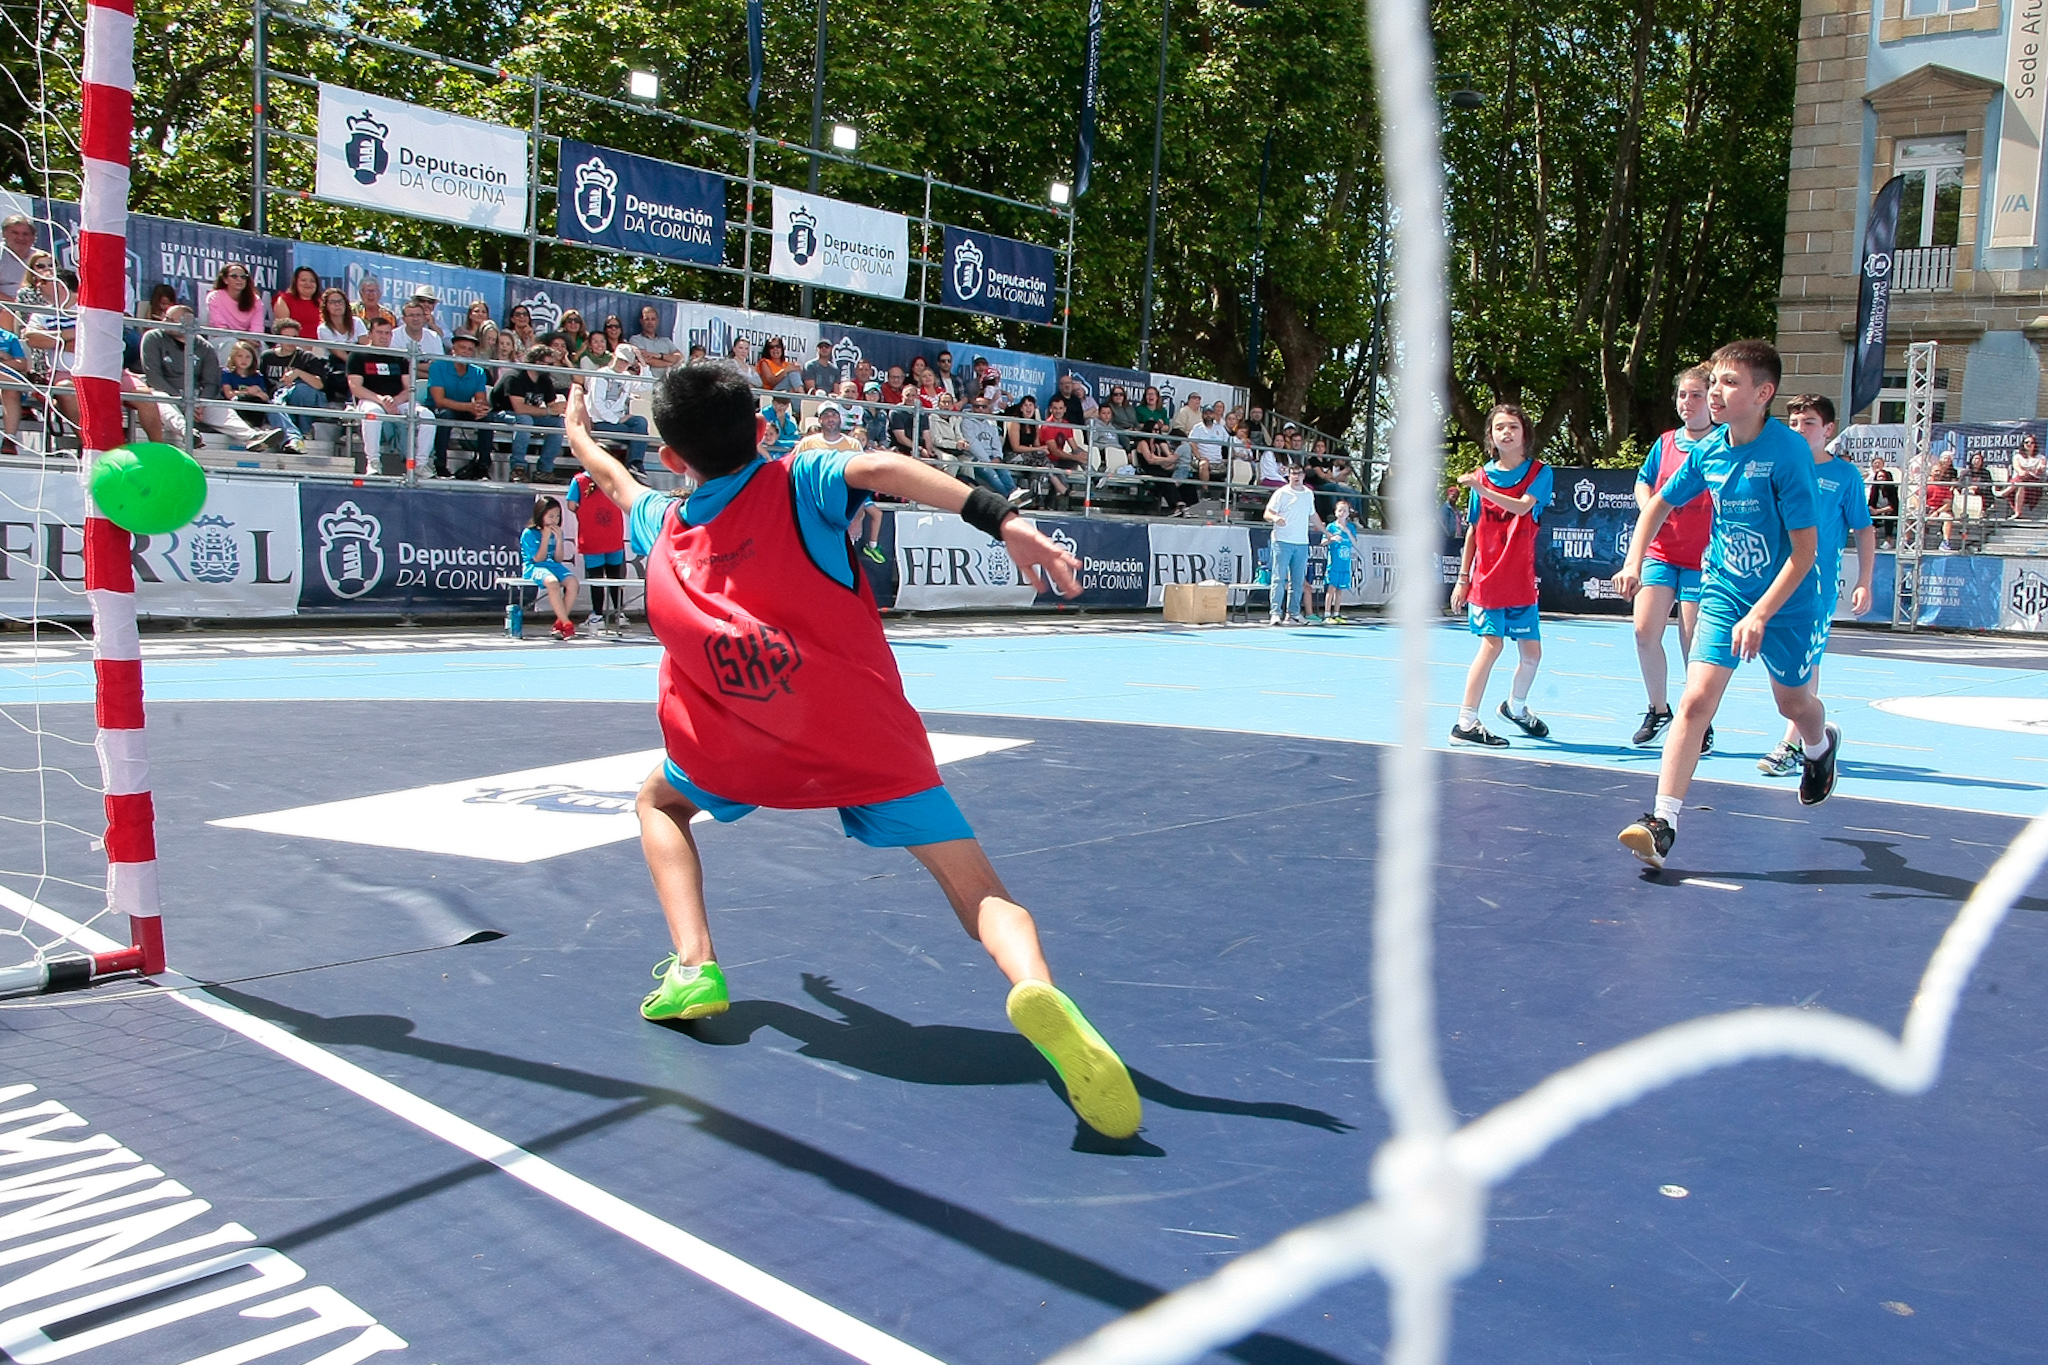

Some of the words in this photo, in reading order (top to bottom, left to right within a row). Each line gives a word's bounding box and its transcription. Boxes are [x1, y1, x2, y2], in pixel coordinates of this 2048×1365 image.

[2014, 43, 2039, 99] Sede
[399, 147, 508, 185] Deputación
[399, 169, 425, 191] DA
[431, 176, 506, 206] CORUÑA
[625, 194, 713, 228] Deputación
[624, 213, 646, 234] DA
[650, 220, 712, 247] CORUÑA
[161, 242, 224, 260] DEPUTACIÓN
[227, 252, 241, 262] DA
[824, 233, 895, 260] Deputación
[822, 251, 840, 267] DA
[842, 255, 894, 277] CORUÑA
[987, 268, 1047, 293] Deputación
[986, 283, 1002, 299] DA
[1003, 287, 1046, 307] CORUÑA
[1884, 452, 1897, 463] DE
[1552, 531, 1595, 541] BALONMAN
[398, 543, 520, 571] Deputación
[1083, 556, 1144, 575] Deputación
[396, 569, 428, 588] DA
[1083, 575, 1098, 590] DA
[1099, 574, 1143, 590] CORUÑA
